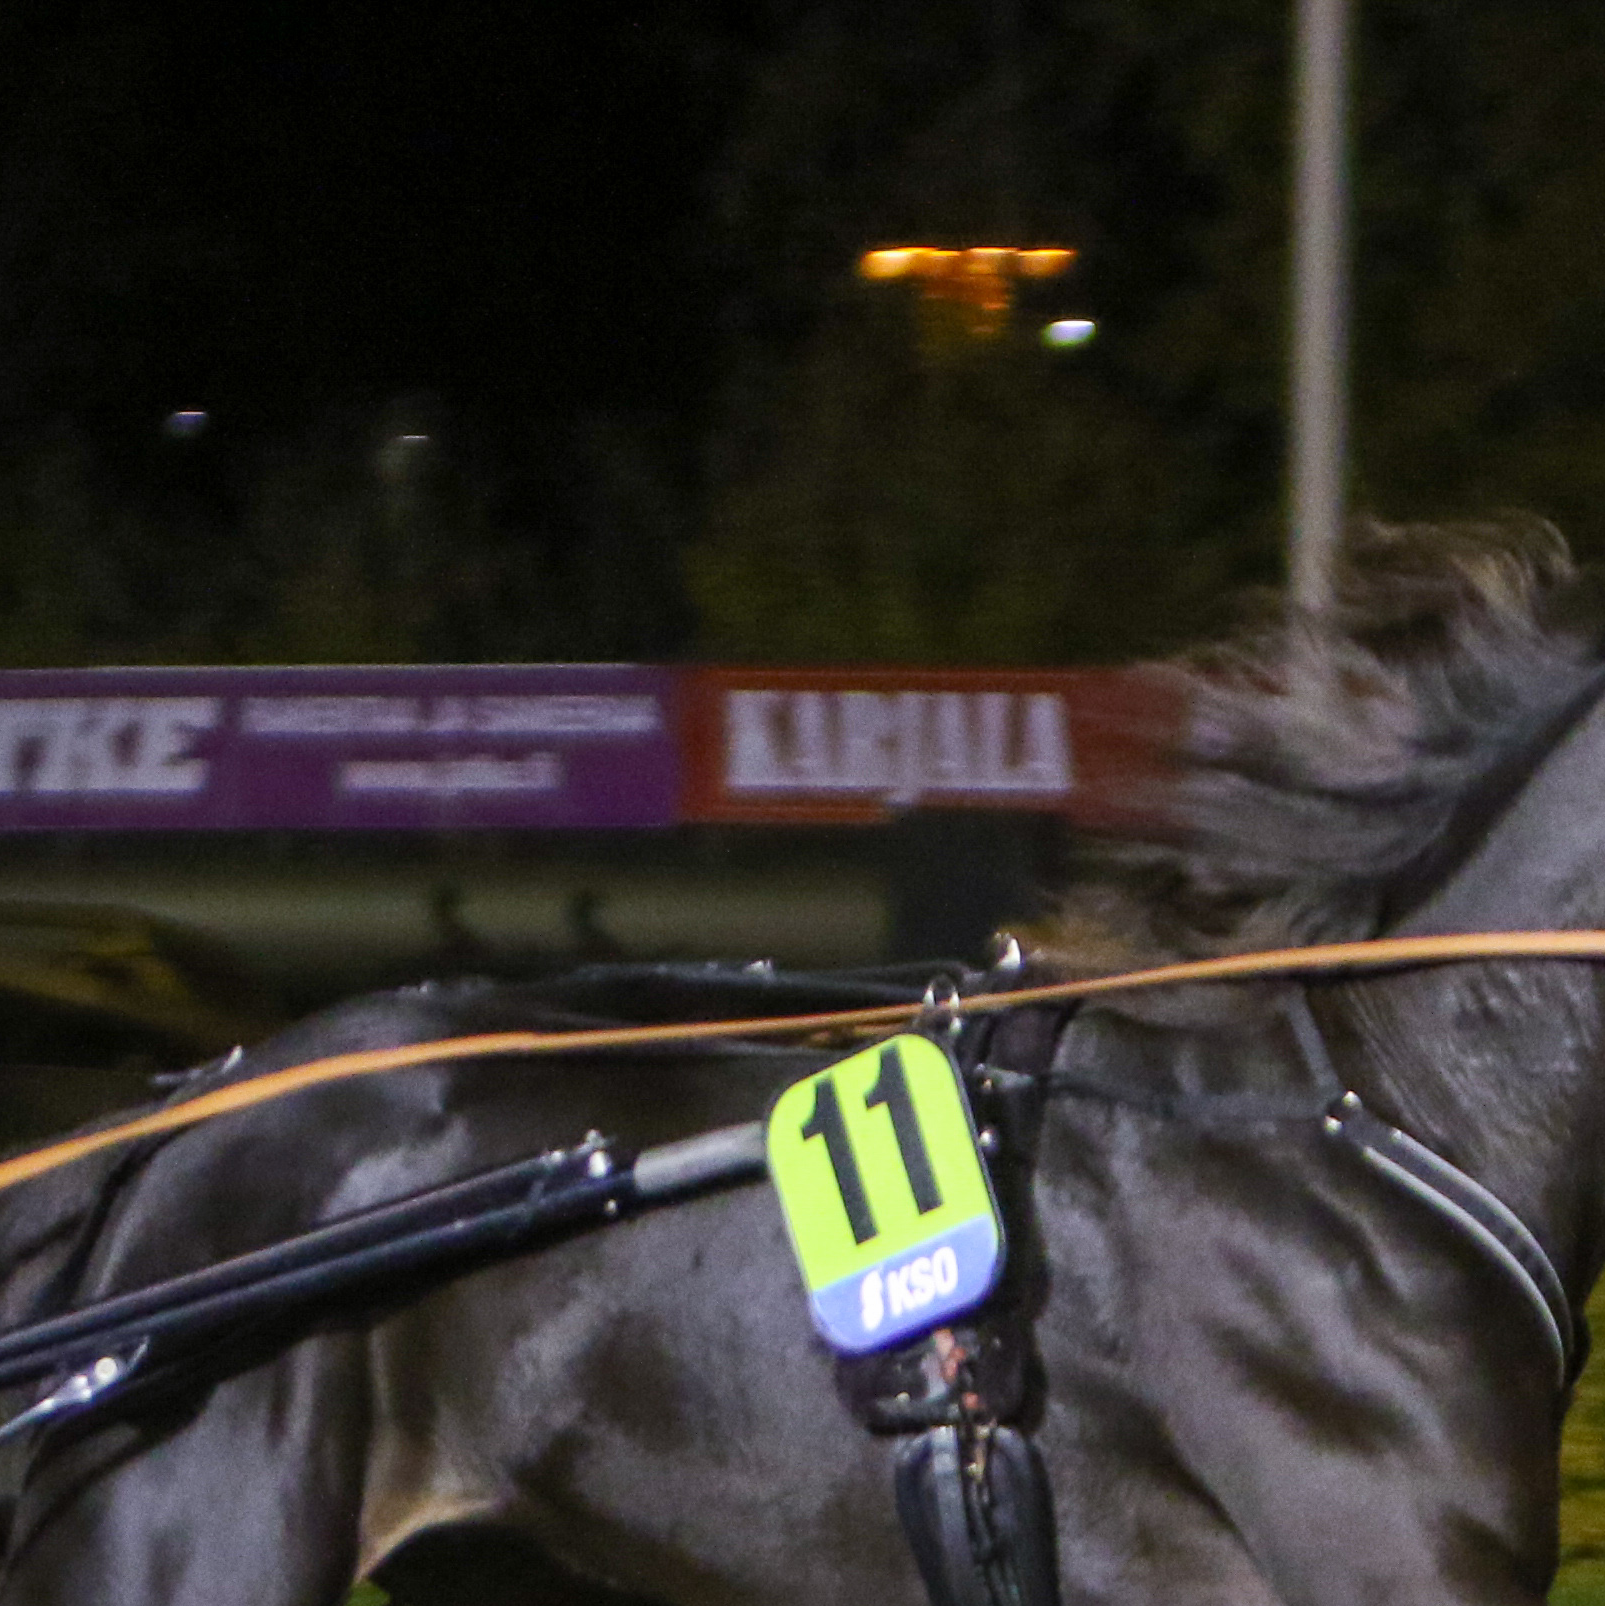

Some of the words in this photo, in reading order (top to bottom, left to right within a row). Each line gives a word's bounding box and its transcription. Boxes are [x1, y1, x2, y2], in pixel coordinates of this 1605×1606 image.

[722, 690, 1072, 804] KARJALA
[802, 1040, 943, 1246] 11
[886, 1246, 959, 1317] KSO
